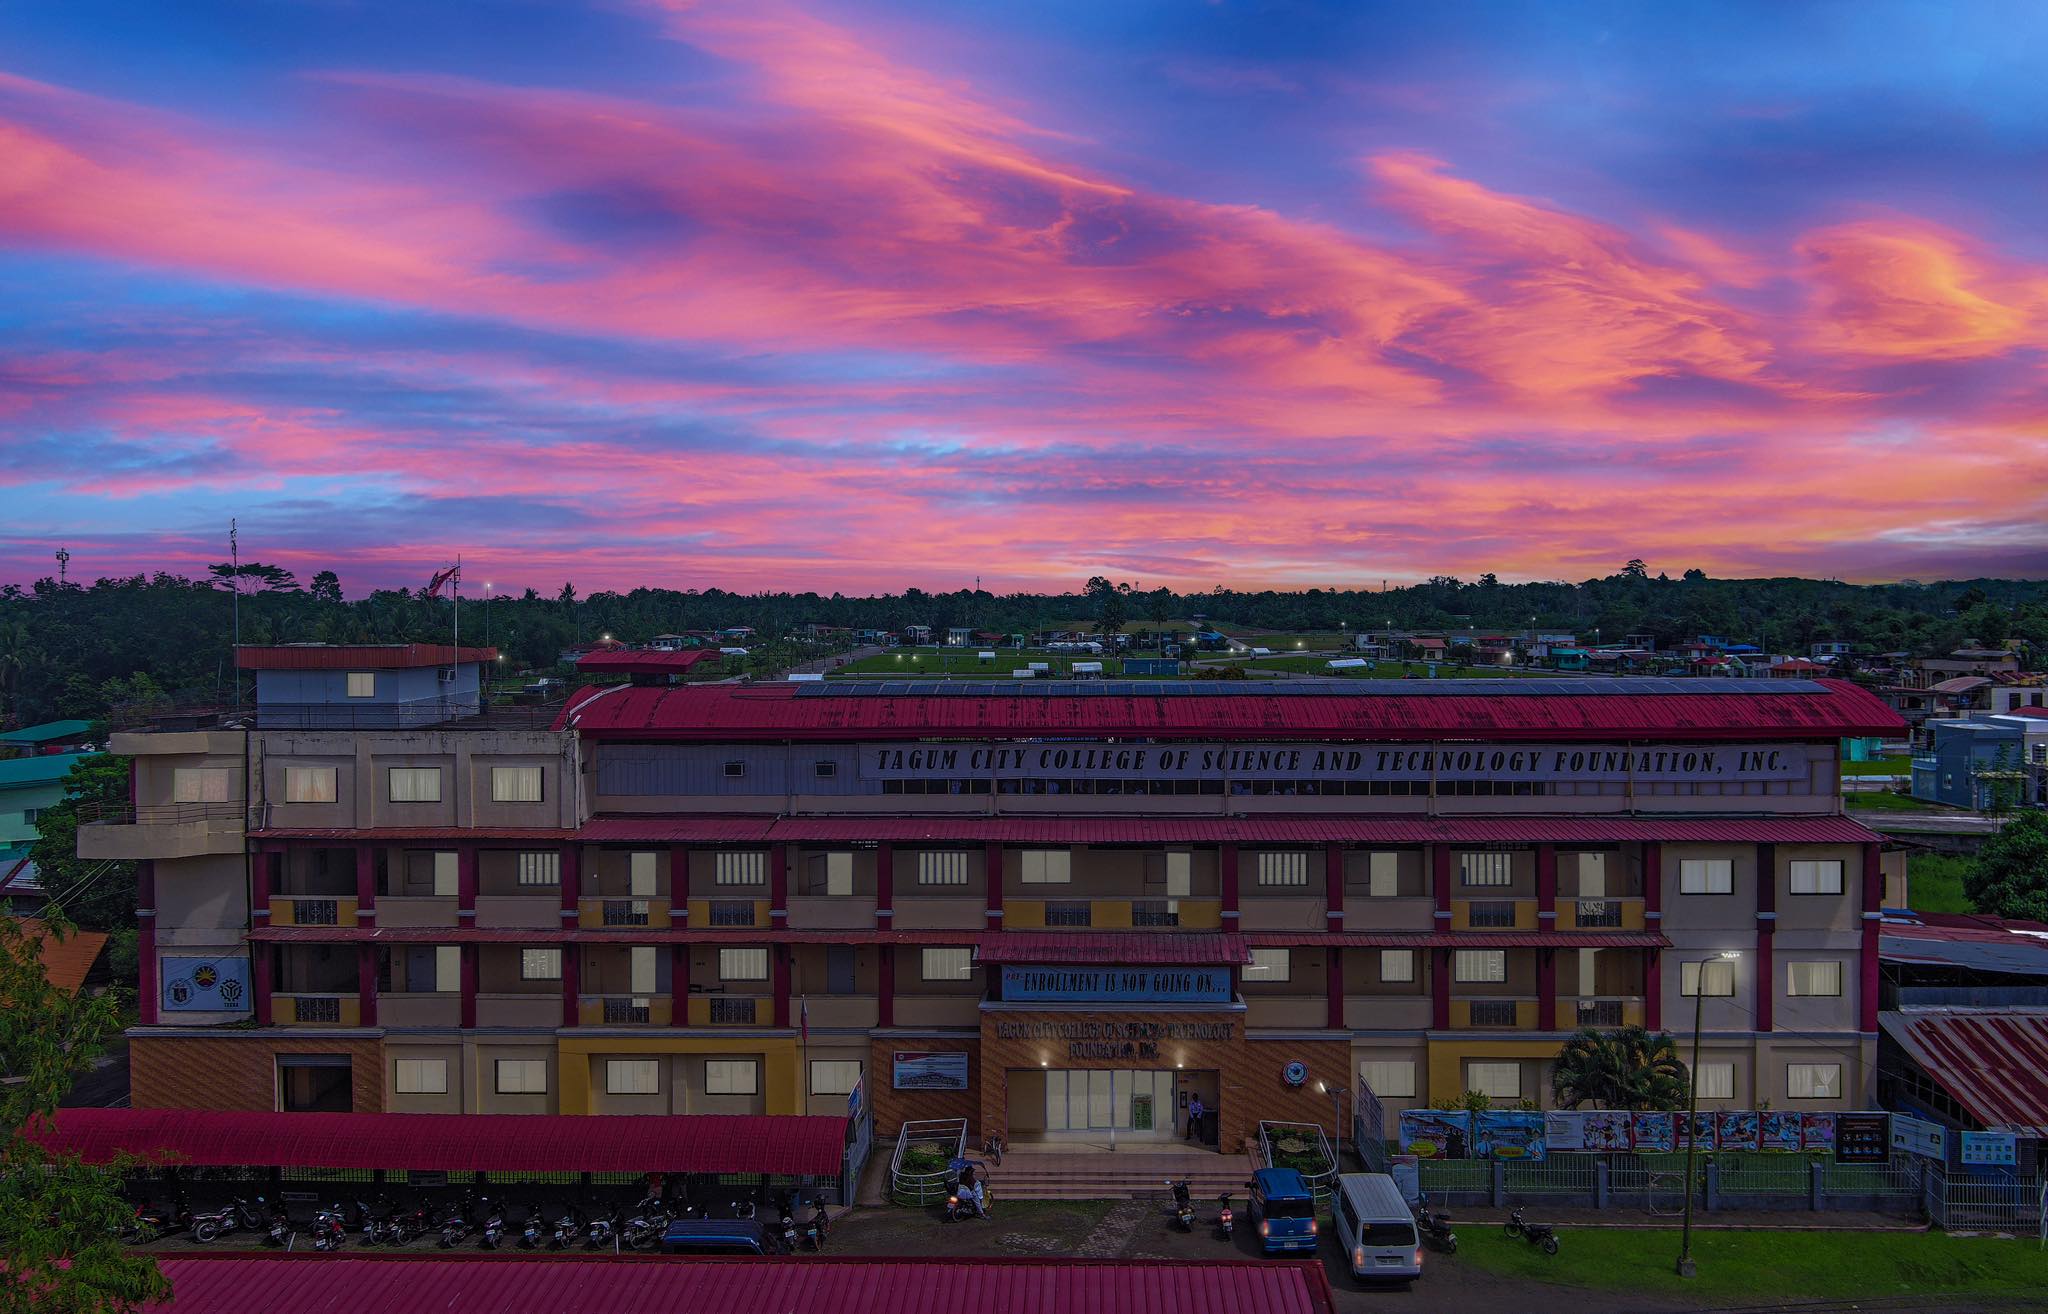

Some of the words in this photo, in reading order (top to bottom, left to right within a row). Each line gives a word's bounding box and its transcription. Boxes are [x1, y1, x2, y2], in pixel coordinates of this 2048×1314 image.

[878, 749, 957, 770] TAGUM
[971, 749, 1026, 770] CITY
[1039, 749, 1146, 770] COLLEGE
[1159, 750, 1189, 770] OF
[1202, 750, 1301, 771] SCIENCE
[1312, 750, 1361, 771] AND
[1376, 751, 1542, 771] TECHNOLOGY
[1553, 751, 1723, 774] FOUNDATION,
[1738, 751, 1789, 772] INC.
[1105, 973, 1116, 992] IS
[1121, 973, 1148, 992] NOW
[1153, 973, 1191, 992] GOING
